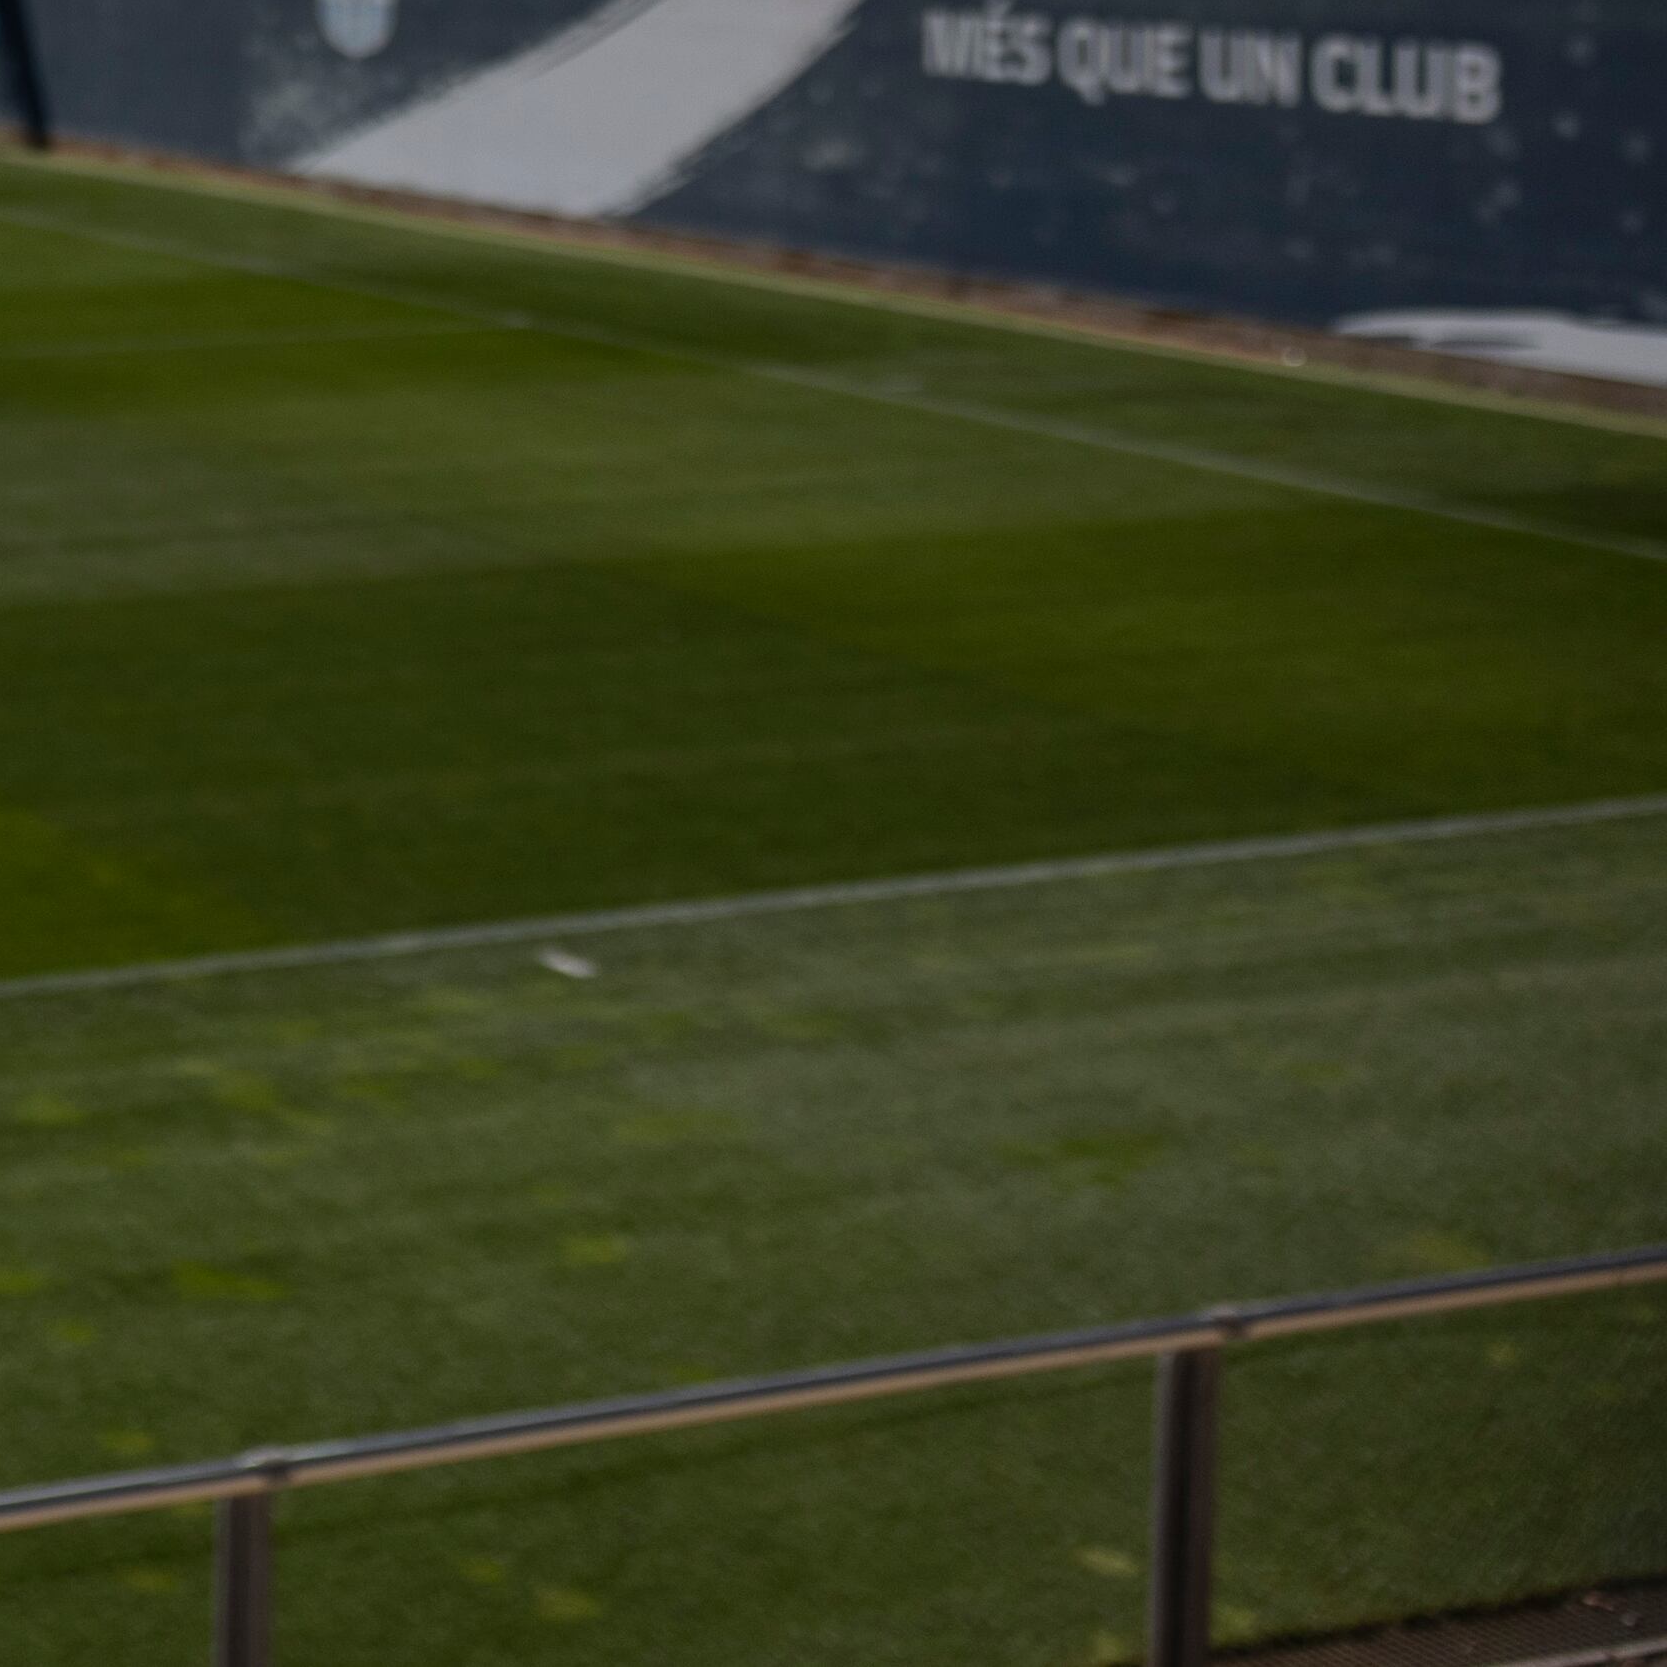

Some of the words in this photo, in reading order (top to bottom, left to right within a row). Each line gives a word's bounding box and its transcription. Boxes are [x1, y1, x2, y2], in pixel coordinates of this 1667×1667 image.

[1057, 16, 1191, 105] QUE
[1198, 25, 1304, 108] UN
[1311, 35, 1503, 126] CLUB
